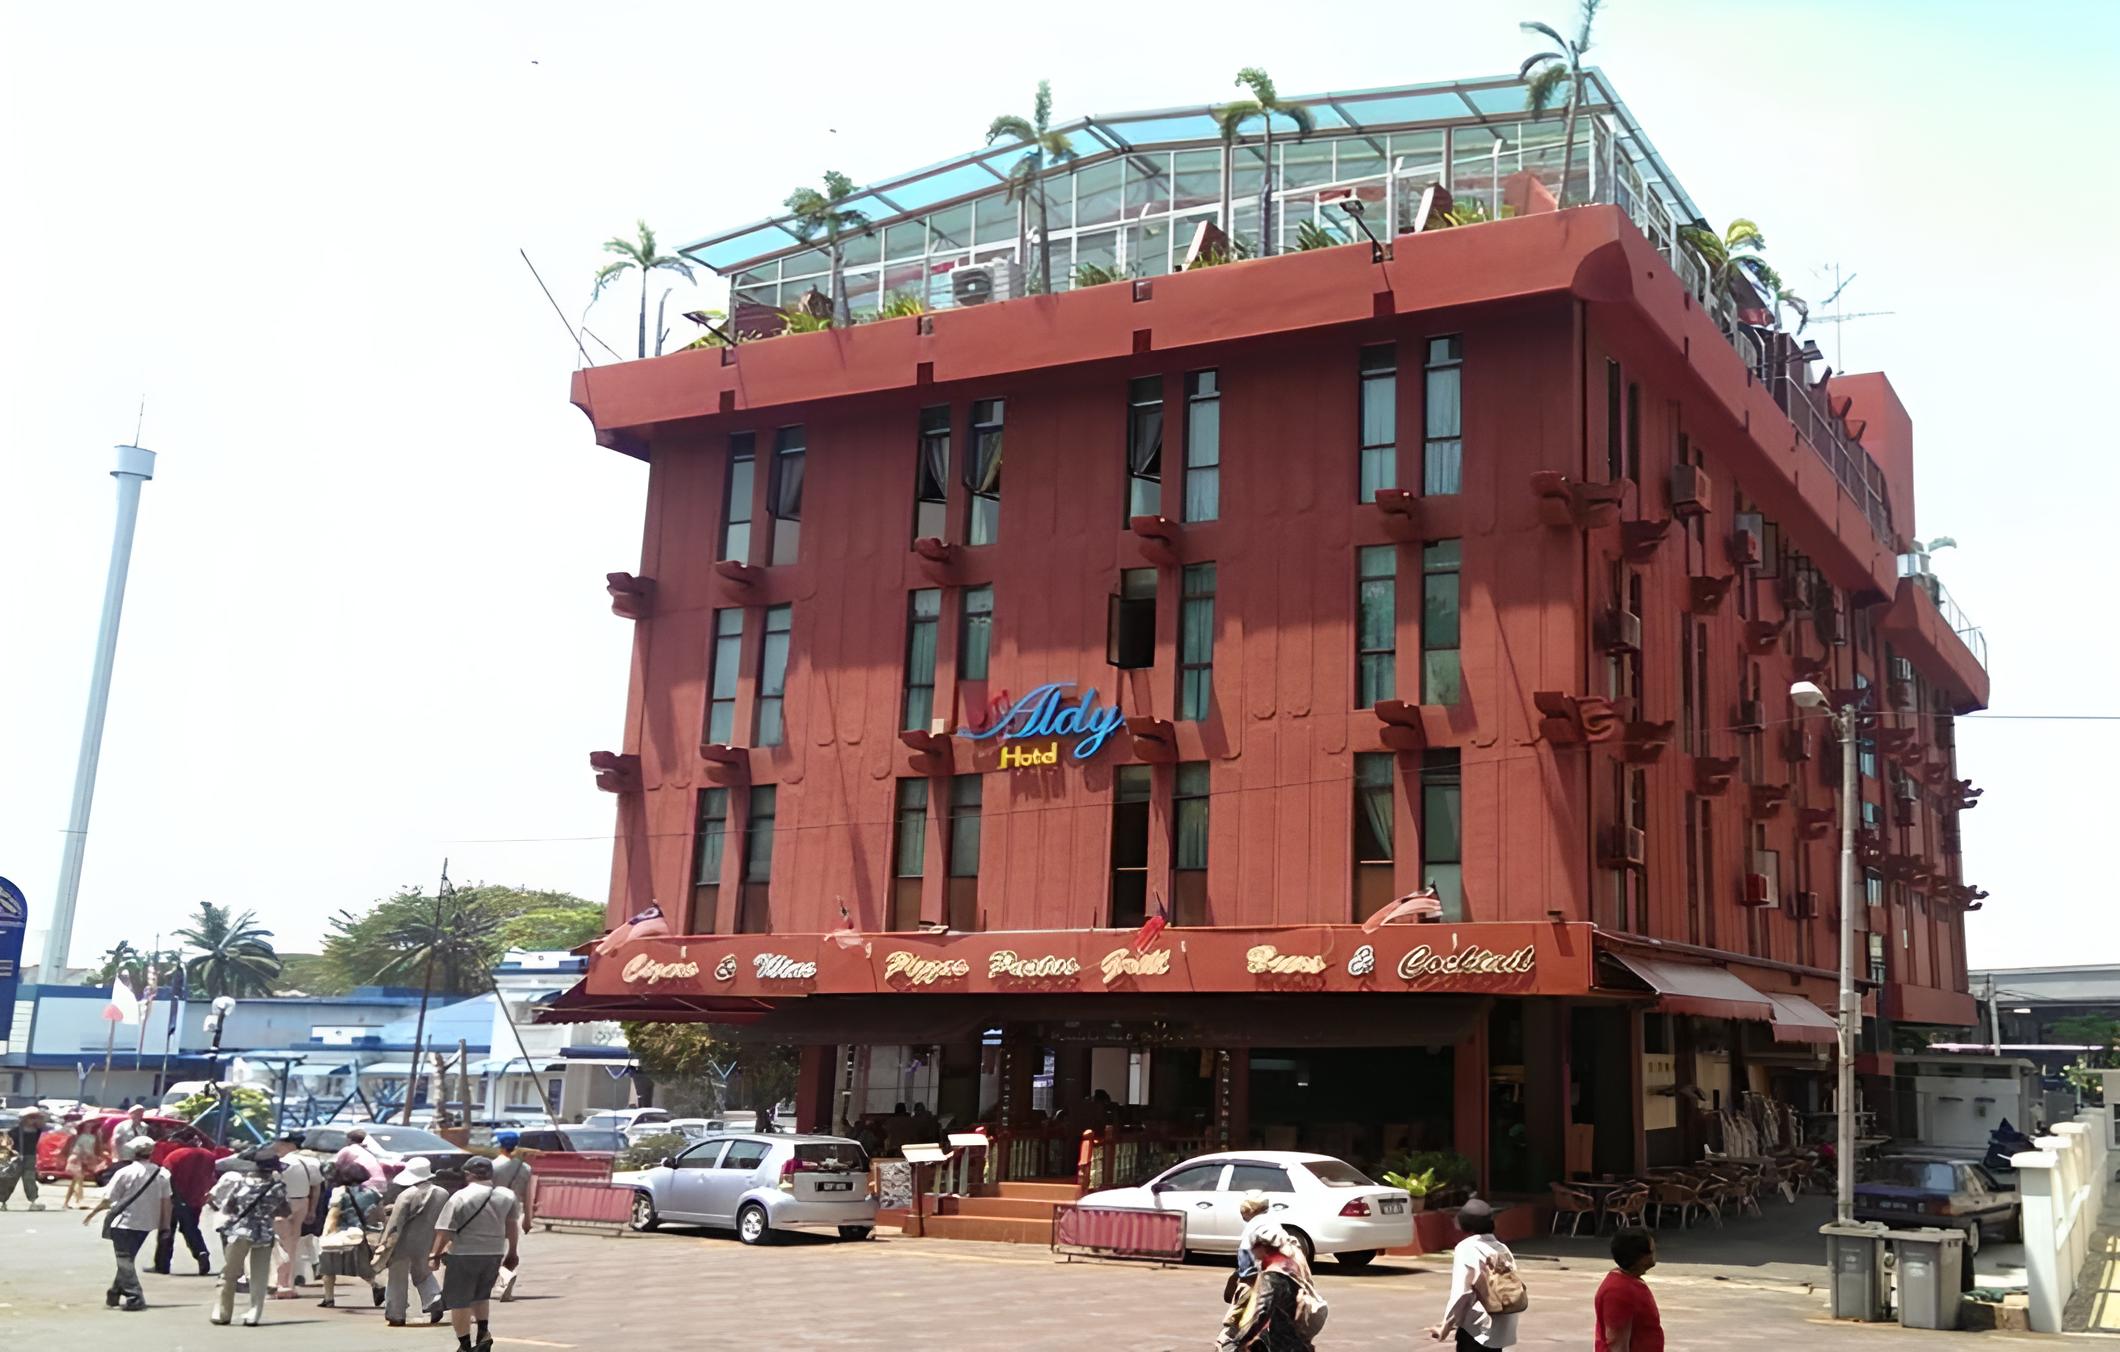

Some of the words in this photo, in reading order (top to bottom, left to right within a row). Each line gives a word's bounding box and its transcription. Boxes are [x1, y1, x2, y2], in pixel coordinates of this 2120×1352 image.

[957, 682, 1125, 759] Aldy
[1000, 742, 1058, 769] Hotel
[714, 953, 737, 981] &
[1348, 945, 1375, 976] &
